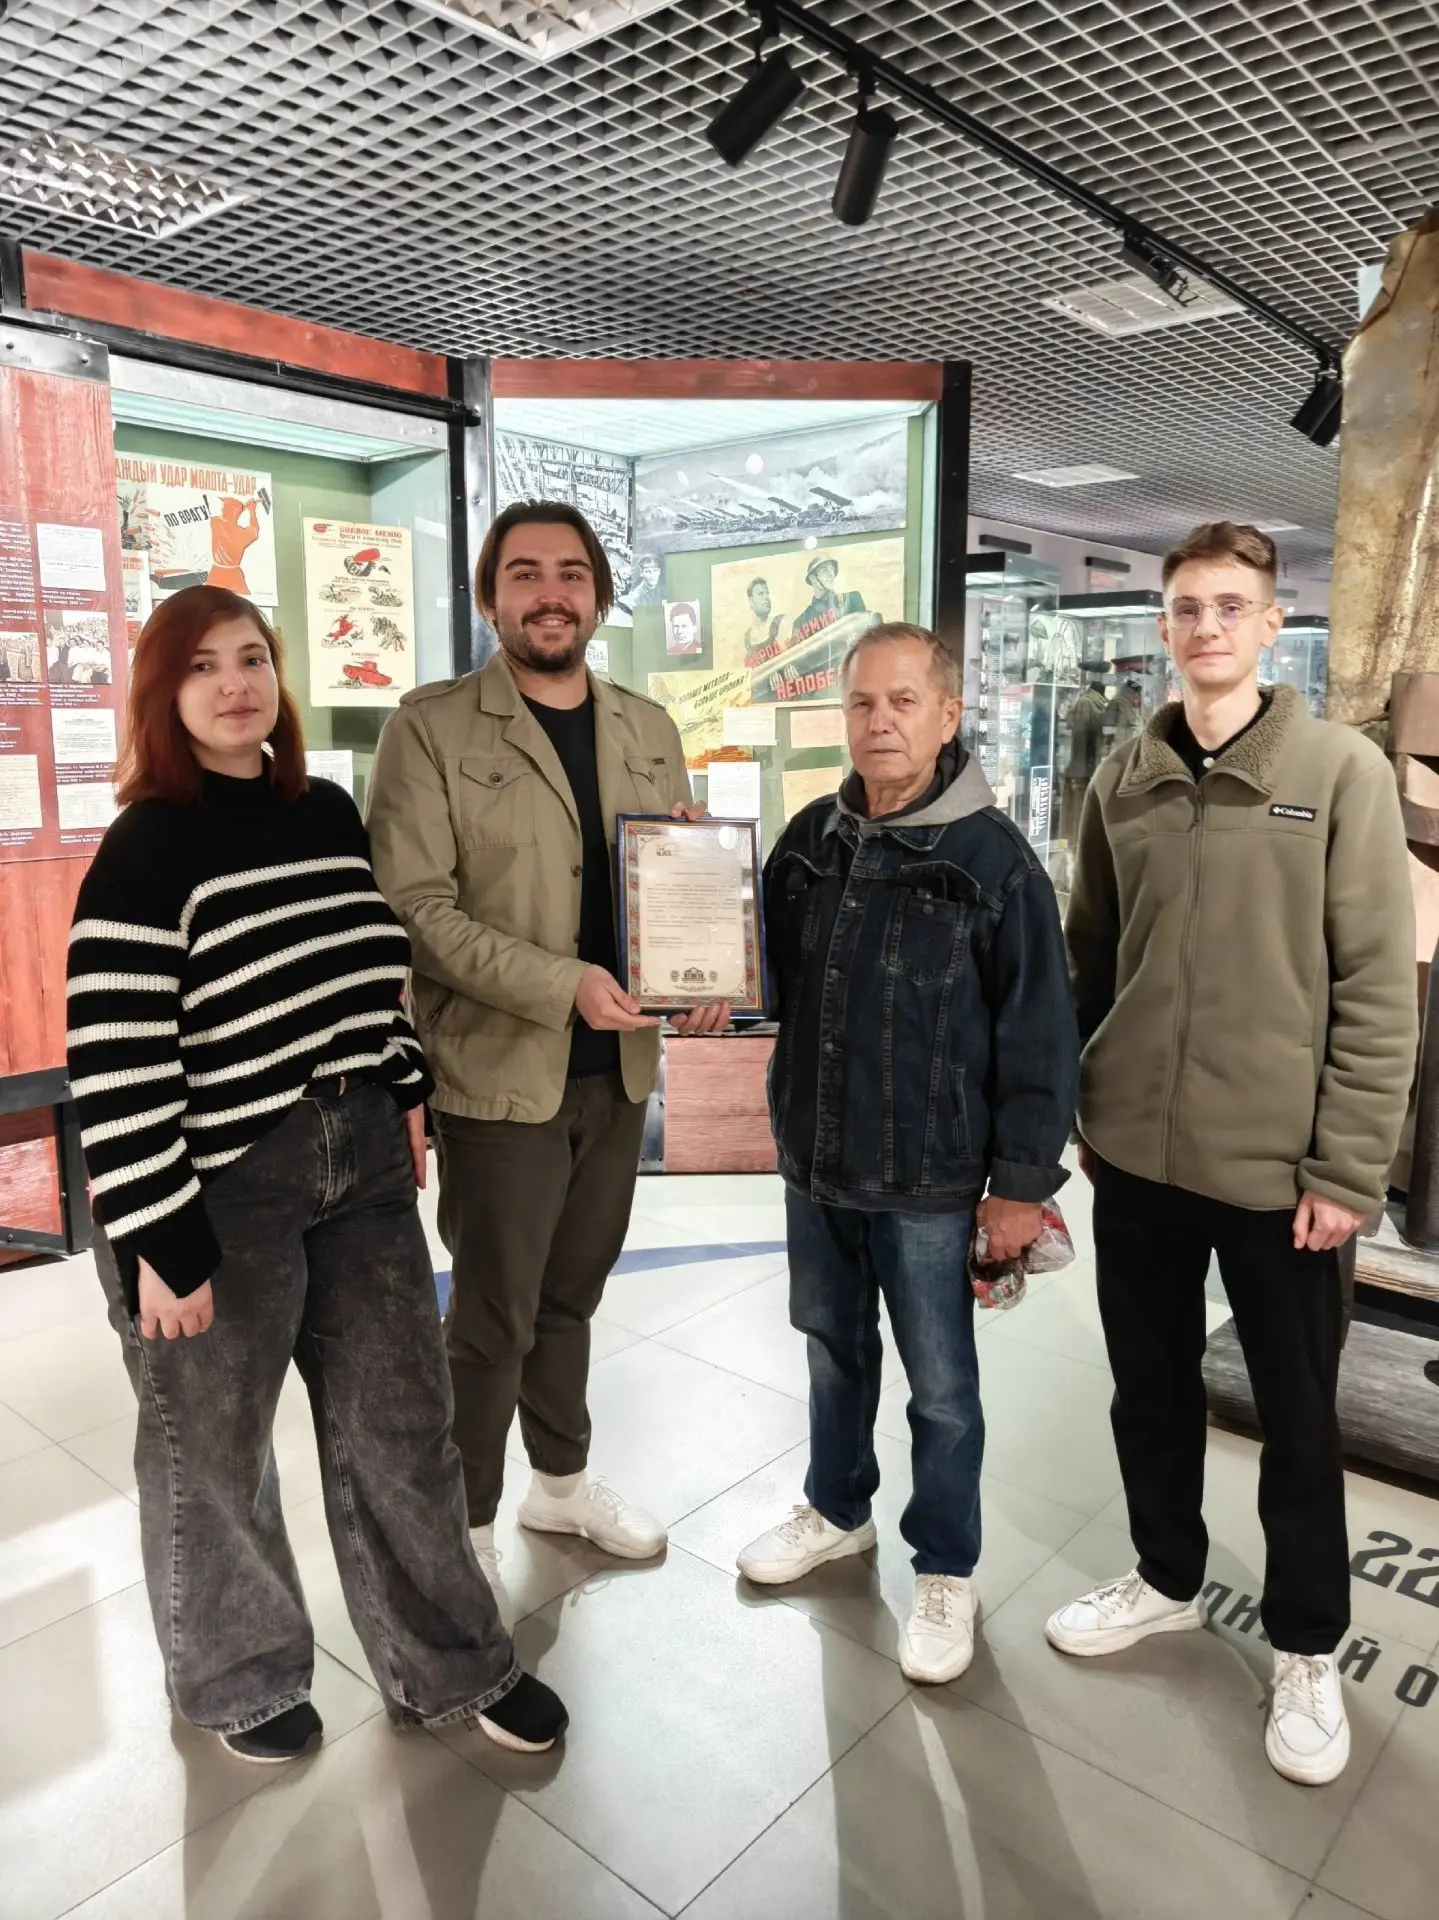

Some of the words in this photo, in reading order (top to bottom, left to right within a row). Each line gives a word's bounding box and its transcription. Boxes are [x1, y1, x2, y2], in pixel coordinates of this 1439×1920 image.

[115, 457, 157, 484] АЖДЫЙ
[160, 463, 187, 488] УДАР
[164, 513, 179, 527] ПО
[178, 494, 212, 524] ВРАГУ!
[796, 607, 837, 643] АРМИЯ
[1280, 807, 1313, 818] Columbia
